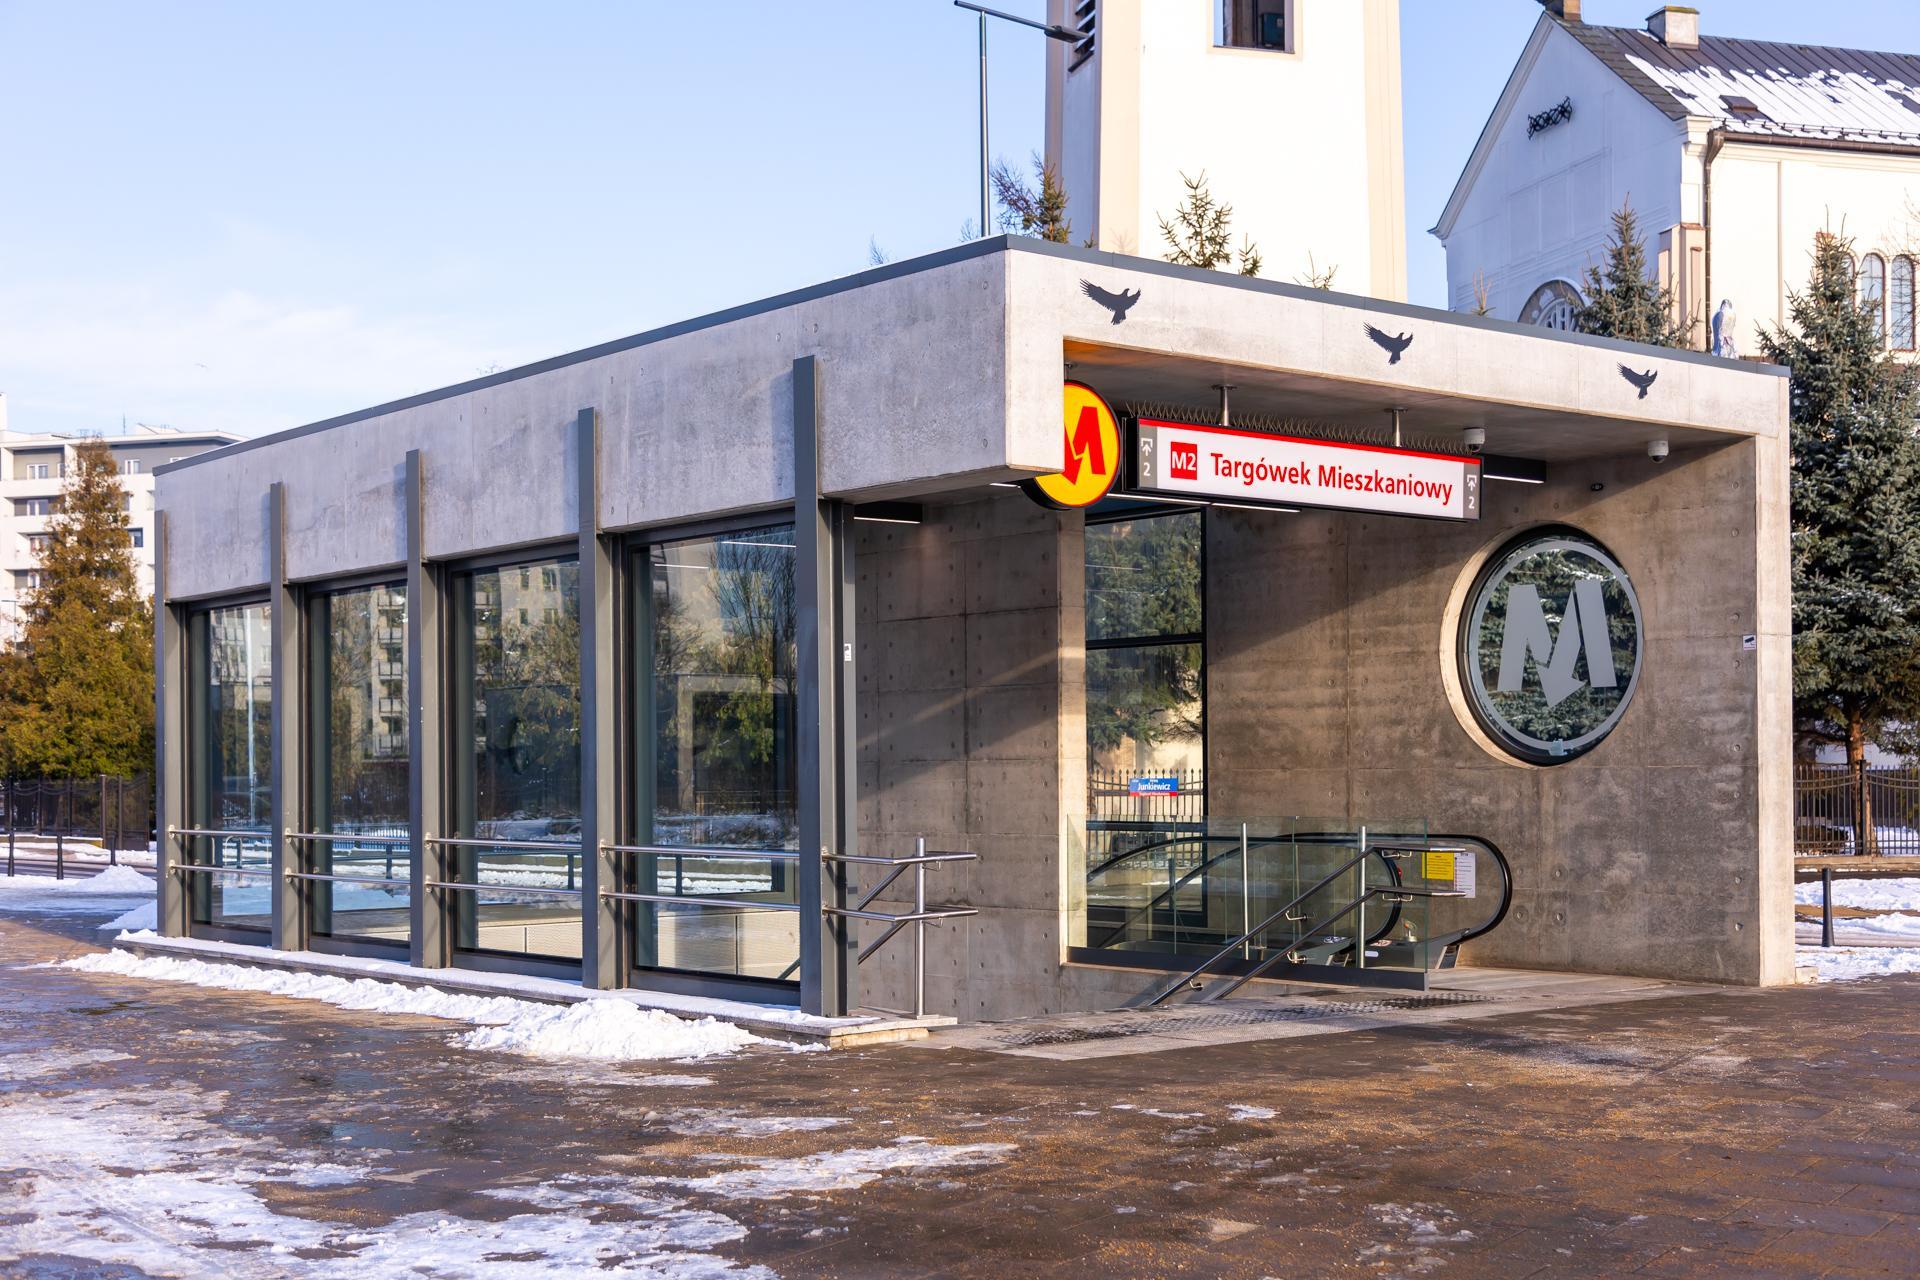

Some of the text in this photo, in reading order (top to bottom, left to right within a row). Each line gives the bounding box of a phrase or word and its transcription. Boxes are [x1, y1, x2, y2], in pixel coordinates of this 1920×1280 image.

[1143, 461, 1151, 477] 2
[1171, 450, 1453, 506] M2 Targówek Mieszkaniowy
[1468, 496, 1475, 509] 2
[1137, 782, 1171, 791] Junkiewicz
